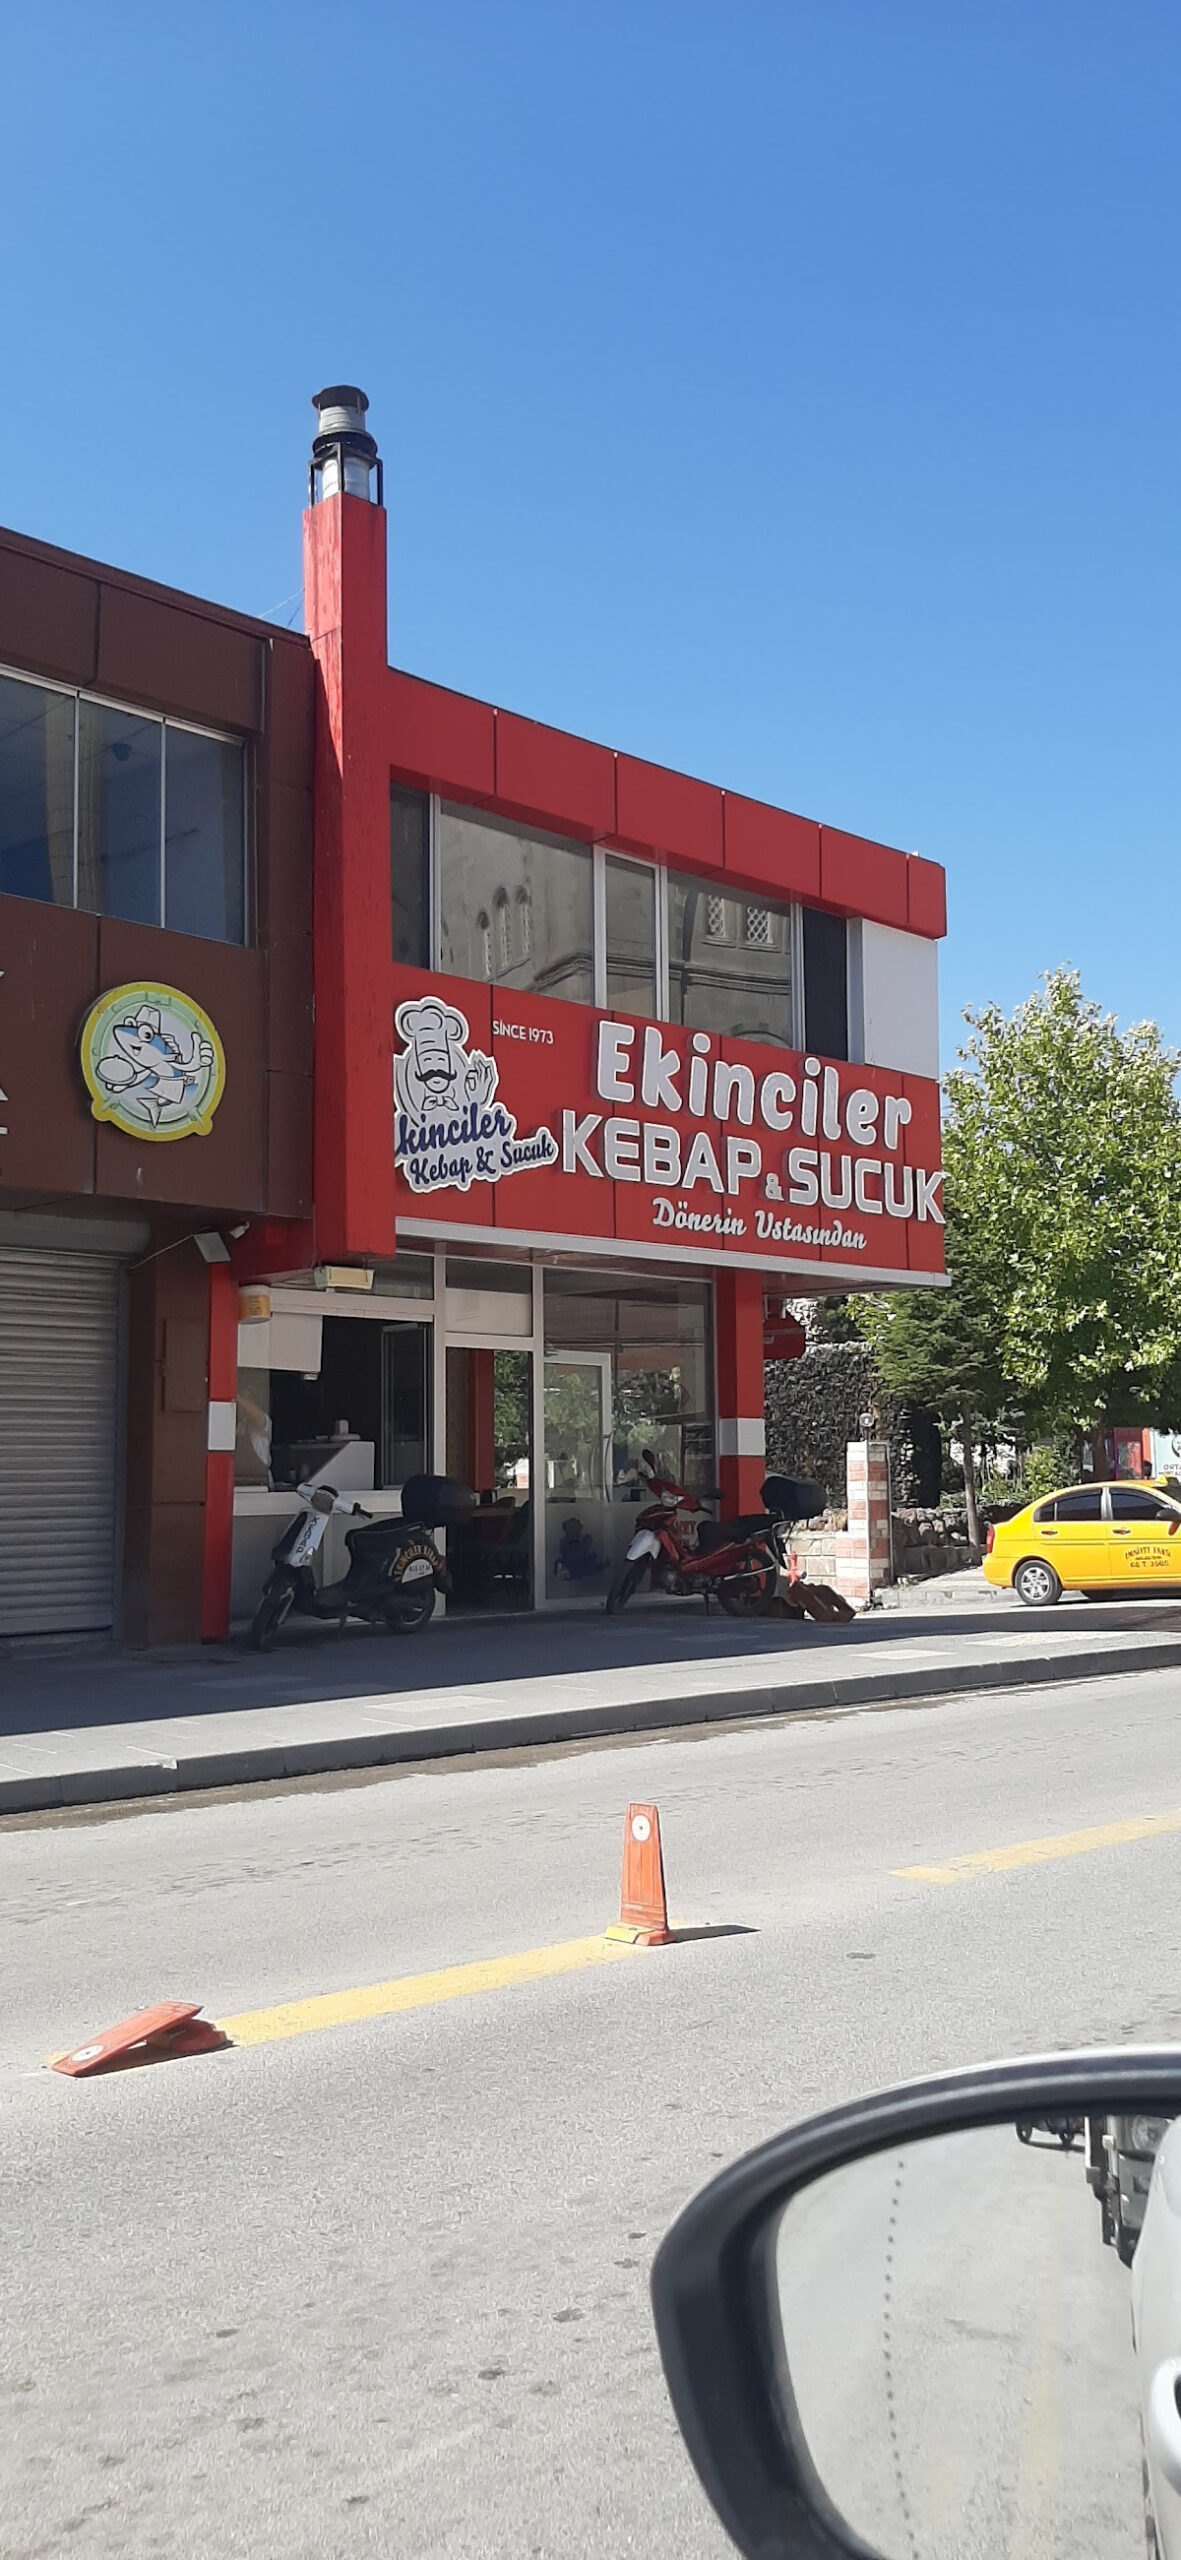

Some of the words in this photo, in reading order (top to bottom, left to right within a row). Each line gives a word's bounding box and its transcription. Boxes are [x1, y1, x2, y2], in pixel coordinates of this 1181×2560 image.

[529, 1027, 554, 1045] 1973
[597, 1020, 912, 1150] Ekinciler
[395, 1102, 512, 1156] kinciler
[410, 1153, 473, 1185] Kebap
[476, 1146, 496, 1174] &
[500, 1133, 554, 1168] Sucuk
[562, 1108, 762, 1196] KEBAP
[765, 1172, 784, 1201] &
[788, 1147, 947, 1225] SUCUK
[652, 1196, 748, 1236] Dönerin
[754, 1209, 868, 1250] Ustasından
